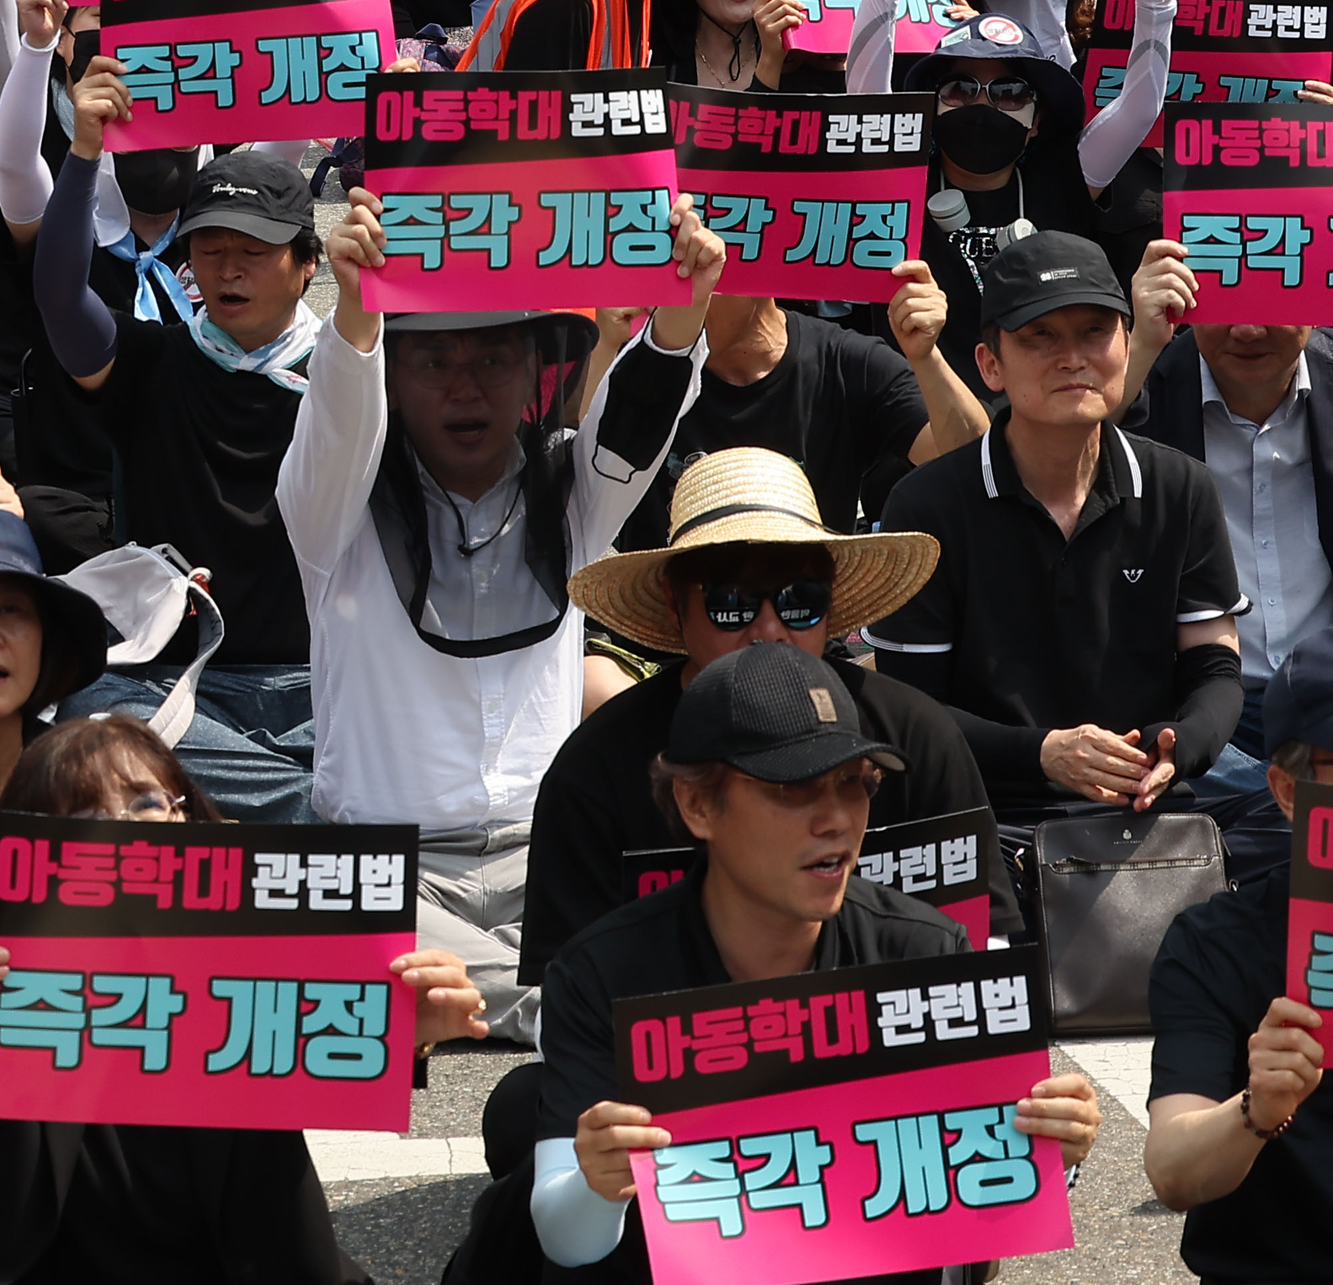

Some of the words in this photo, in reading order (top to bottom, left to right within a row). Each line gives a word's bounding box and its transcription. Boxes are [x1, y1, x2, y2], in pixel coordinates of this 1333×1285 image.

[117, 42, 240, 110] 즉각
[258, 32, 379, 103] 개정
[376, 88, 562, 141] 아동학대
[569, 90, 666, 136] 관련법
[380, 194, 519, 268] 즉각
[539, 189, 671, 265] 개정
[252, 854, 404, 910] 관련법
[208, 980, 387, 1077] 개정
[631, 990, 869, 1082] 아동학대
[877, 976, 1030, 1046] 관련법
[656, 1130, 831, 1236] 즉각
[855, 1105, 1036, 1218] 개정
